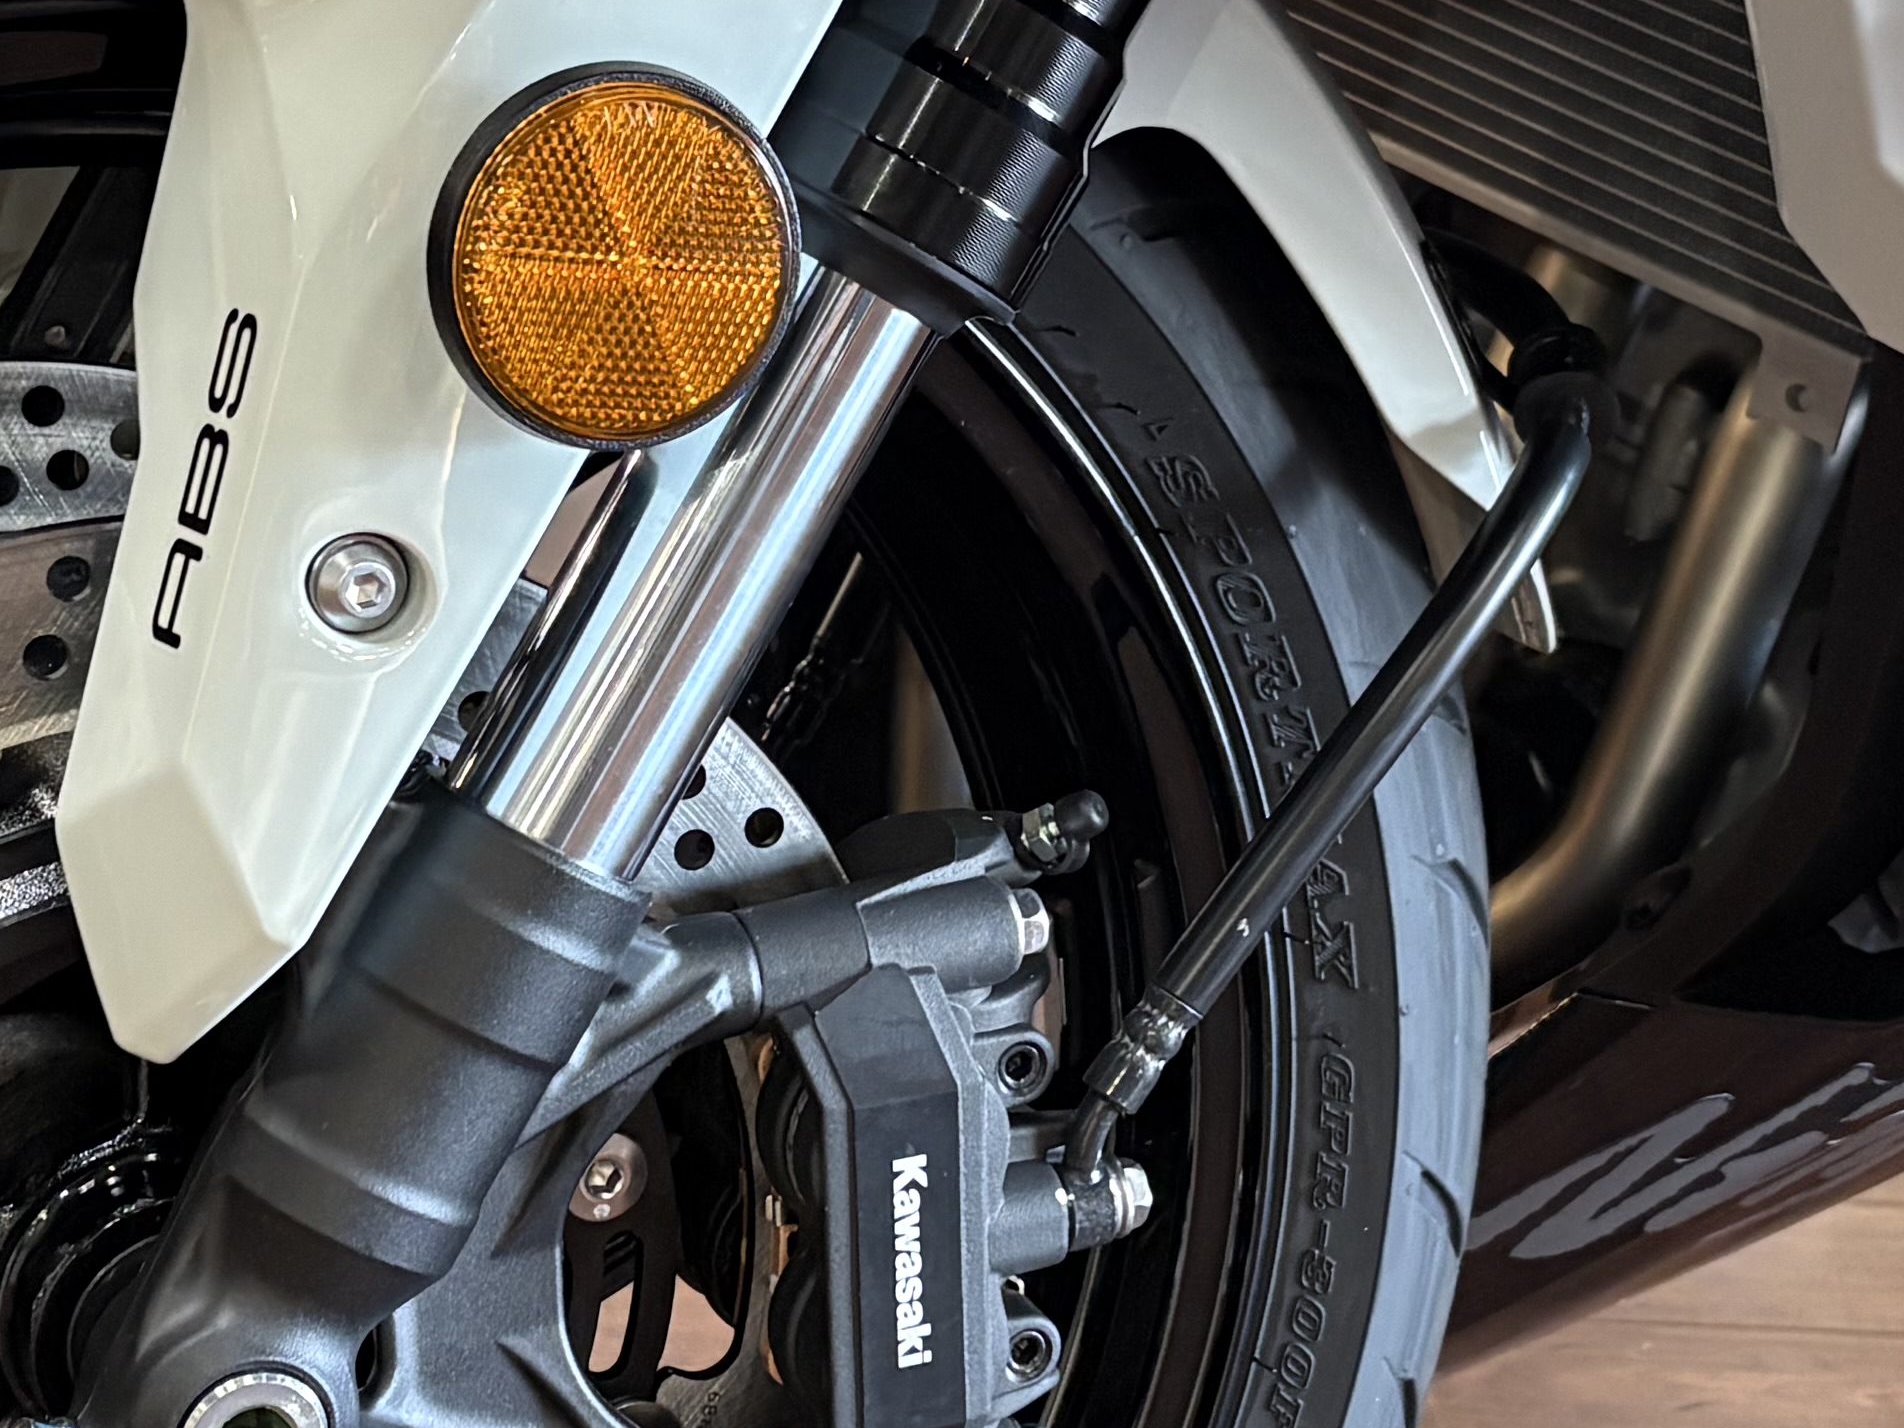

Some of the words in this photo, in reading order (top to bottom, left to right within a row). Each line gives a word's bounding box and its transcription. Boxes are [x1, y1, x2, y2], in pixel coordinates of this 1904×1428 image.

[151, 307, 258, 650] ABS
[1146, 451, 1360, 991] SPORTAX
[891, 1152, 933, 1370] Kawasaki
